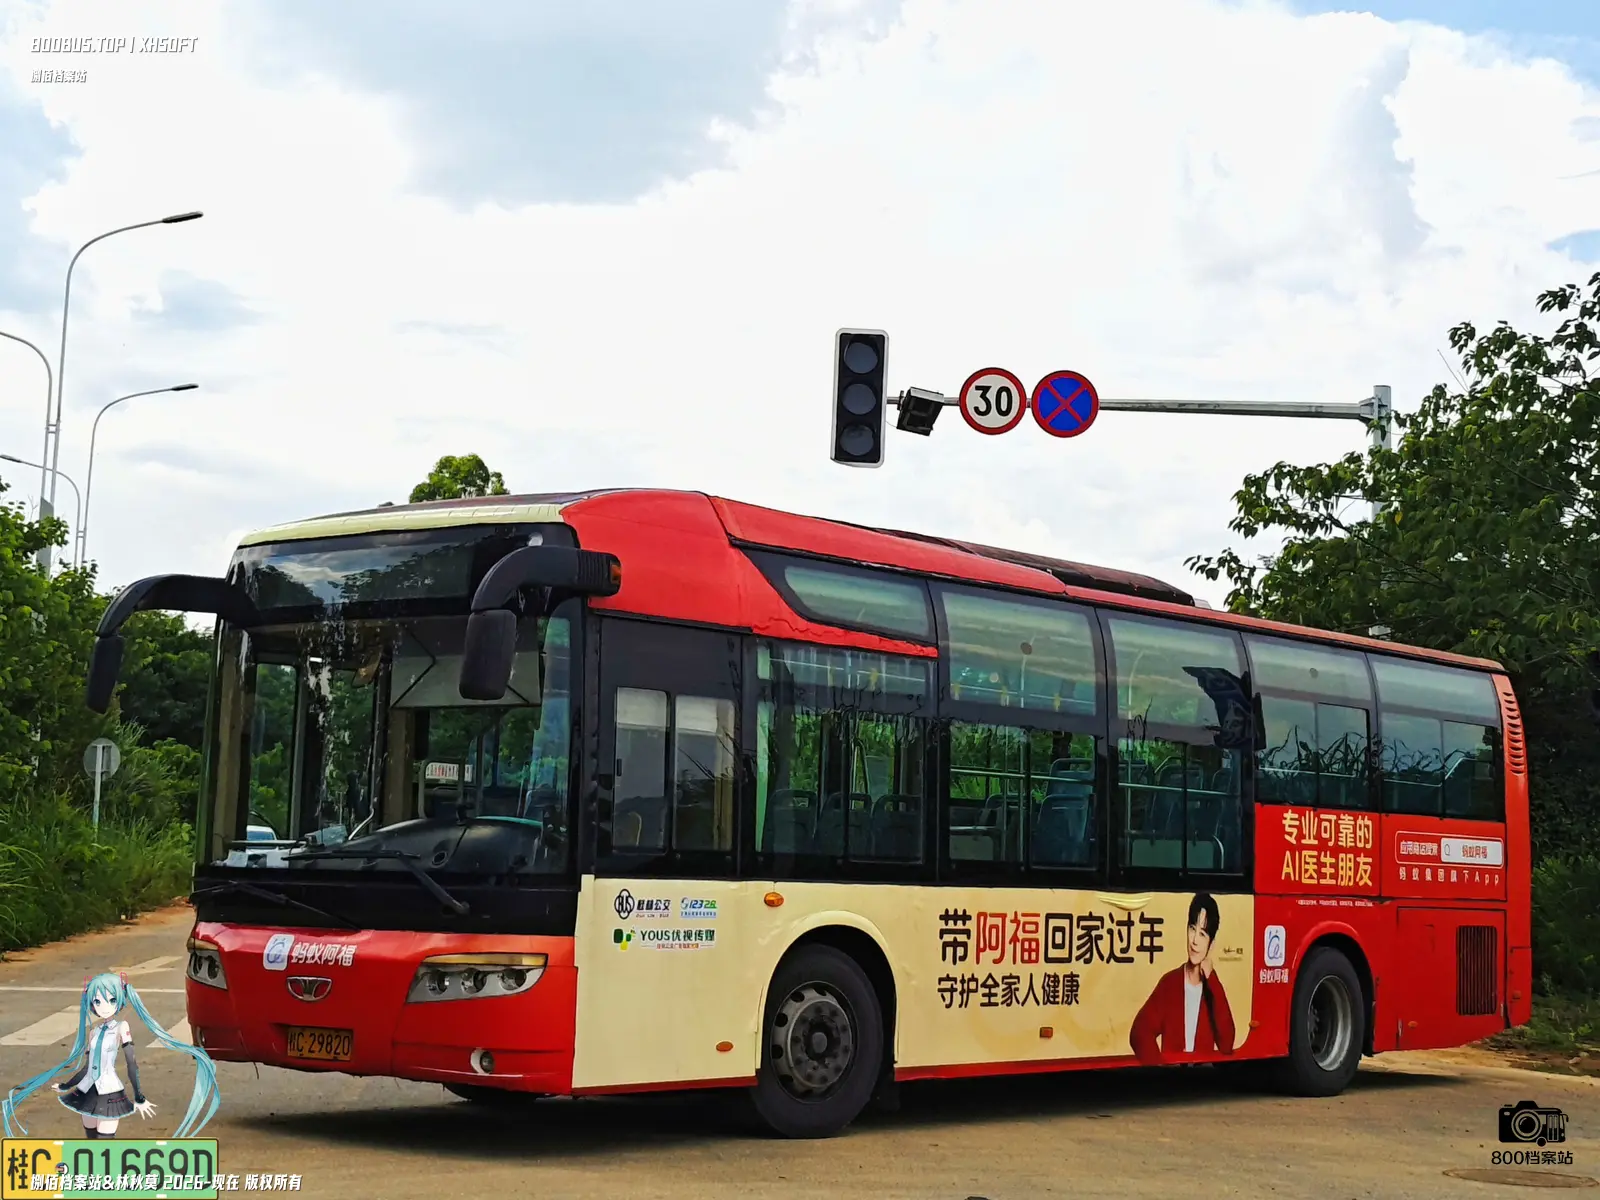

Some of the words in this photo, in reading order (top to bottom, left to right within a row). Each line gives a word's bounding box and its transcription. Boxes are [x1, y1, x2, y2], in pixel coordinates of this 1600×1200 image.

[973, 385, 1013, 417] 30
[1281, 809, 1373, 849] 专业可靠的
[1281, 850, 1373, 887] AI医生朋友
[291, 941, 357, 967] 蚂蚁阿福
[938, 907, 1165, 966] 带阿福回家过年
[937, 972, 1081, 1009] 守护全家人健康
[1259, 968, 1289, 984] 蚂蚁阿福
